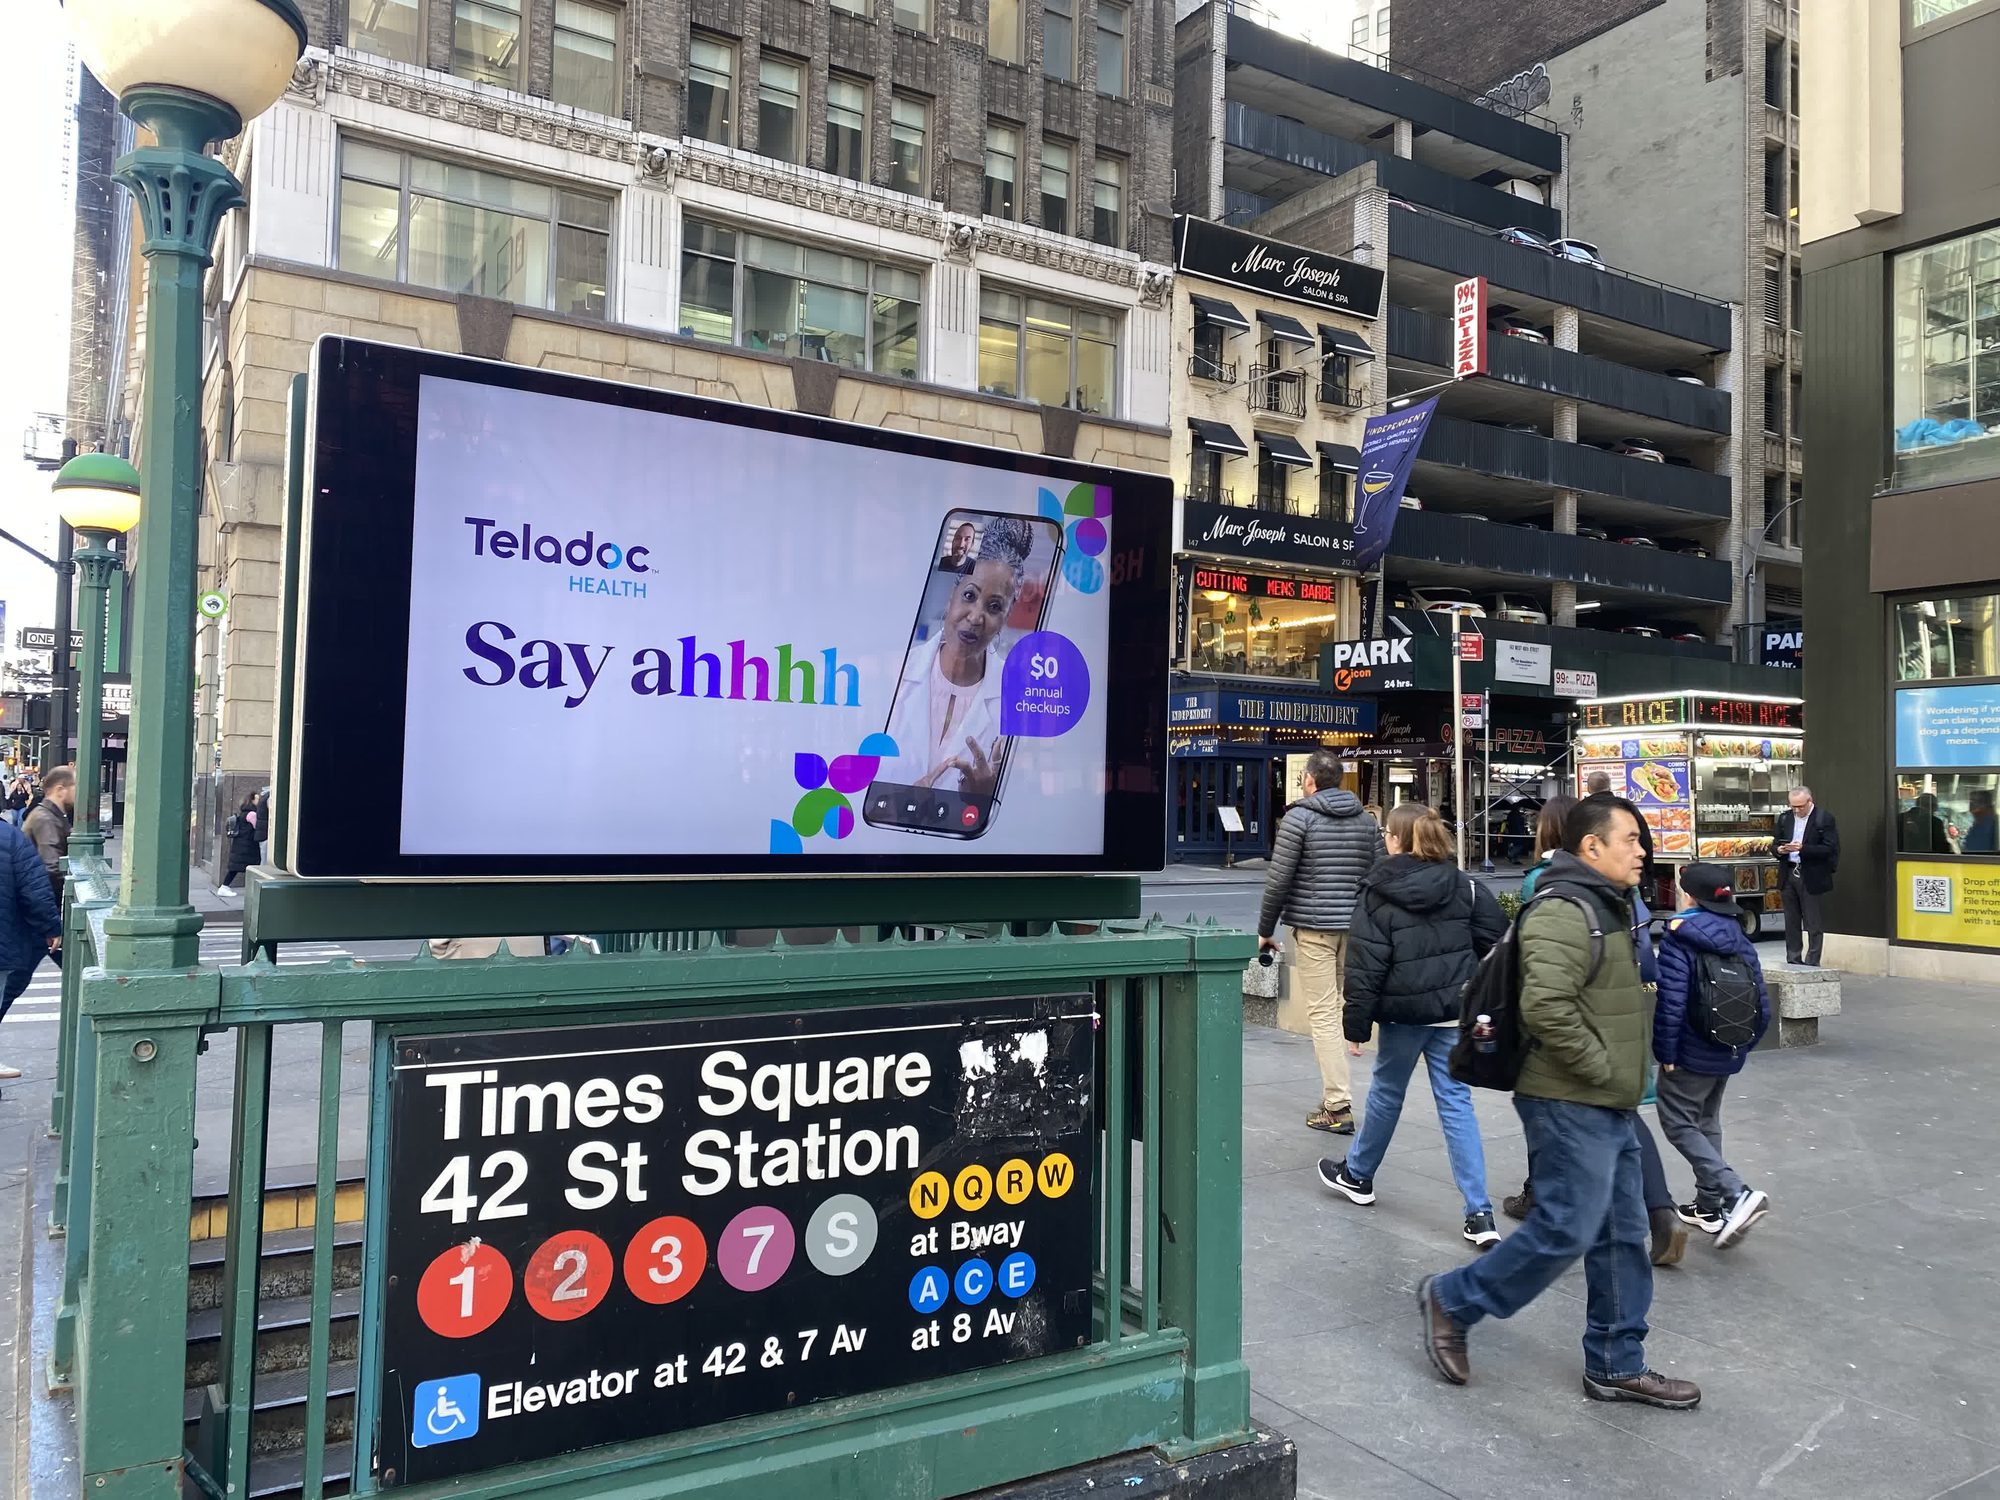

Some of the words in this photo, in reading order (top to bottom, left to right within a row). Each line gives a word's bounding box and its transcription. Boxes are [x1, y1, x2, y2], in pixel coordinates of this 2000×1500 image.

[1232, 244, 1286, 274] Marc
[1284, 257, 1340, 288] Joseph
[1302, 285, 1327, 299] SALON
[1328, 292, 1334, 300] &
[1335, 294, 1349, 304] SPA
[1457, 314, 1474, 374] PIZZA
[464, 516, 650, 573] Teladoc
[1202, 514, 1245, 542] Marc
[1242, 519, 1286, 547] Joseph
[1293, 532, 1330, 548] SALON
[1332, 538, 1340, 549] &
[1342, 540, 1355, 551] SP
[569, 575, 647, 599] HEALTH
[1196, 571, 1248, 593] CUTTING
[1267, 579, 1295, 597] MENS
[1301, 583, 1335, 601] BARBE
[29, 634, 54, 644] ONE
[1766, 632, 1803, 651] PAR
[462, 621, 615, 708] Say
[630, 635, 862, 707] ahhhh
[1334, 636, 1413, 669] PARK
[1781, 660, 1796, 668] hr.
[1030, 653, 1059, 681] $0
[1350, 668, 1371, 679] icon
[1024, 685, 1063, 699] annual
[1384, 679, 1395, 689] 24
[1397, 679, 1413, 688] hrs.
[1576, 673, 1596, 687] PIZZA
[1015, 700, 1071, 716] checkups
[1171, 707, 1212, 722] INDEPENDENT
[1185, 696, 1198, 709] THE
[1238, 699, 1265, 719] THE
[1270, 700, 1359, 726] INDEPENDENT
[1622, 700, 1675, 726] RICE
[1926, 706, 1979, 715] Wondering
[1991, 706, 2000, 714] yo
[1760, 704, 1791, 727] RICE
[1951, 716, 1978, 724] claim
[1495, 728, 1546, 754] PIZZA
[1919, 728, 1938, 736] dog
[1963, 877, 1986, 886] Drop
[1963, 887, 1990, 895] forms
[1963, 897, 1980, 905] File
[425, 1069, 665, 1140] Times
[698, 1050, 932, 1122] Square
[420, 1150, 528, 1225] 42
[564, 1140, 649, 1210] St
[681, 1117, 920, 1197] Station
[920, 1183, 939, 1209] N
[963, 1176, 983, 1201] Q
[1006, 1170, 1023, 1194] R
[1045, 1163, 1067, 1190] W
[909, 1227, 939, 1257] at
[951, 1220, 1026, 1251] Bway
[449, 1266, 475, 1318] 1
[552, 1249, 588, 1302] 2
[648, 1235, 683, 1284] 3
[742, 1225, 775, 1274] 7
[825, 1211, 859, 1258] S
[918, 1275, 939, 1303] A
[963, 1269, 983, 1296] C
[1009, 1261, 1026, 1289] E
[911, 1320, 941, 1352] at
[952, 1313, 972, 1343] 8
[983, 1308, 1017, 1338] Av
[487, 1367, 640, 1420] Elevator
[653, 1354, 688, 1388] at
[702, 1342, 747, 1378] 42
[760, 1336, 784, 1369] &
[798, 1329, 818, 1361] 7
[829, 1324, 867, 1356] Av
